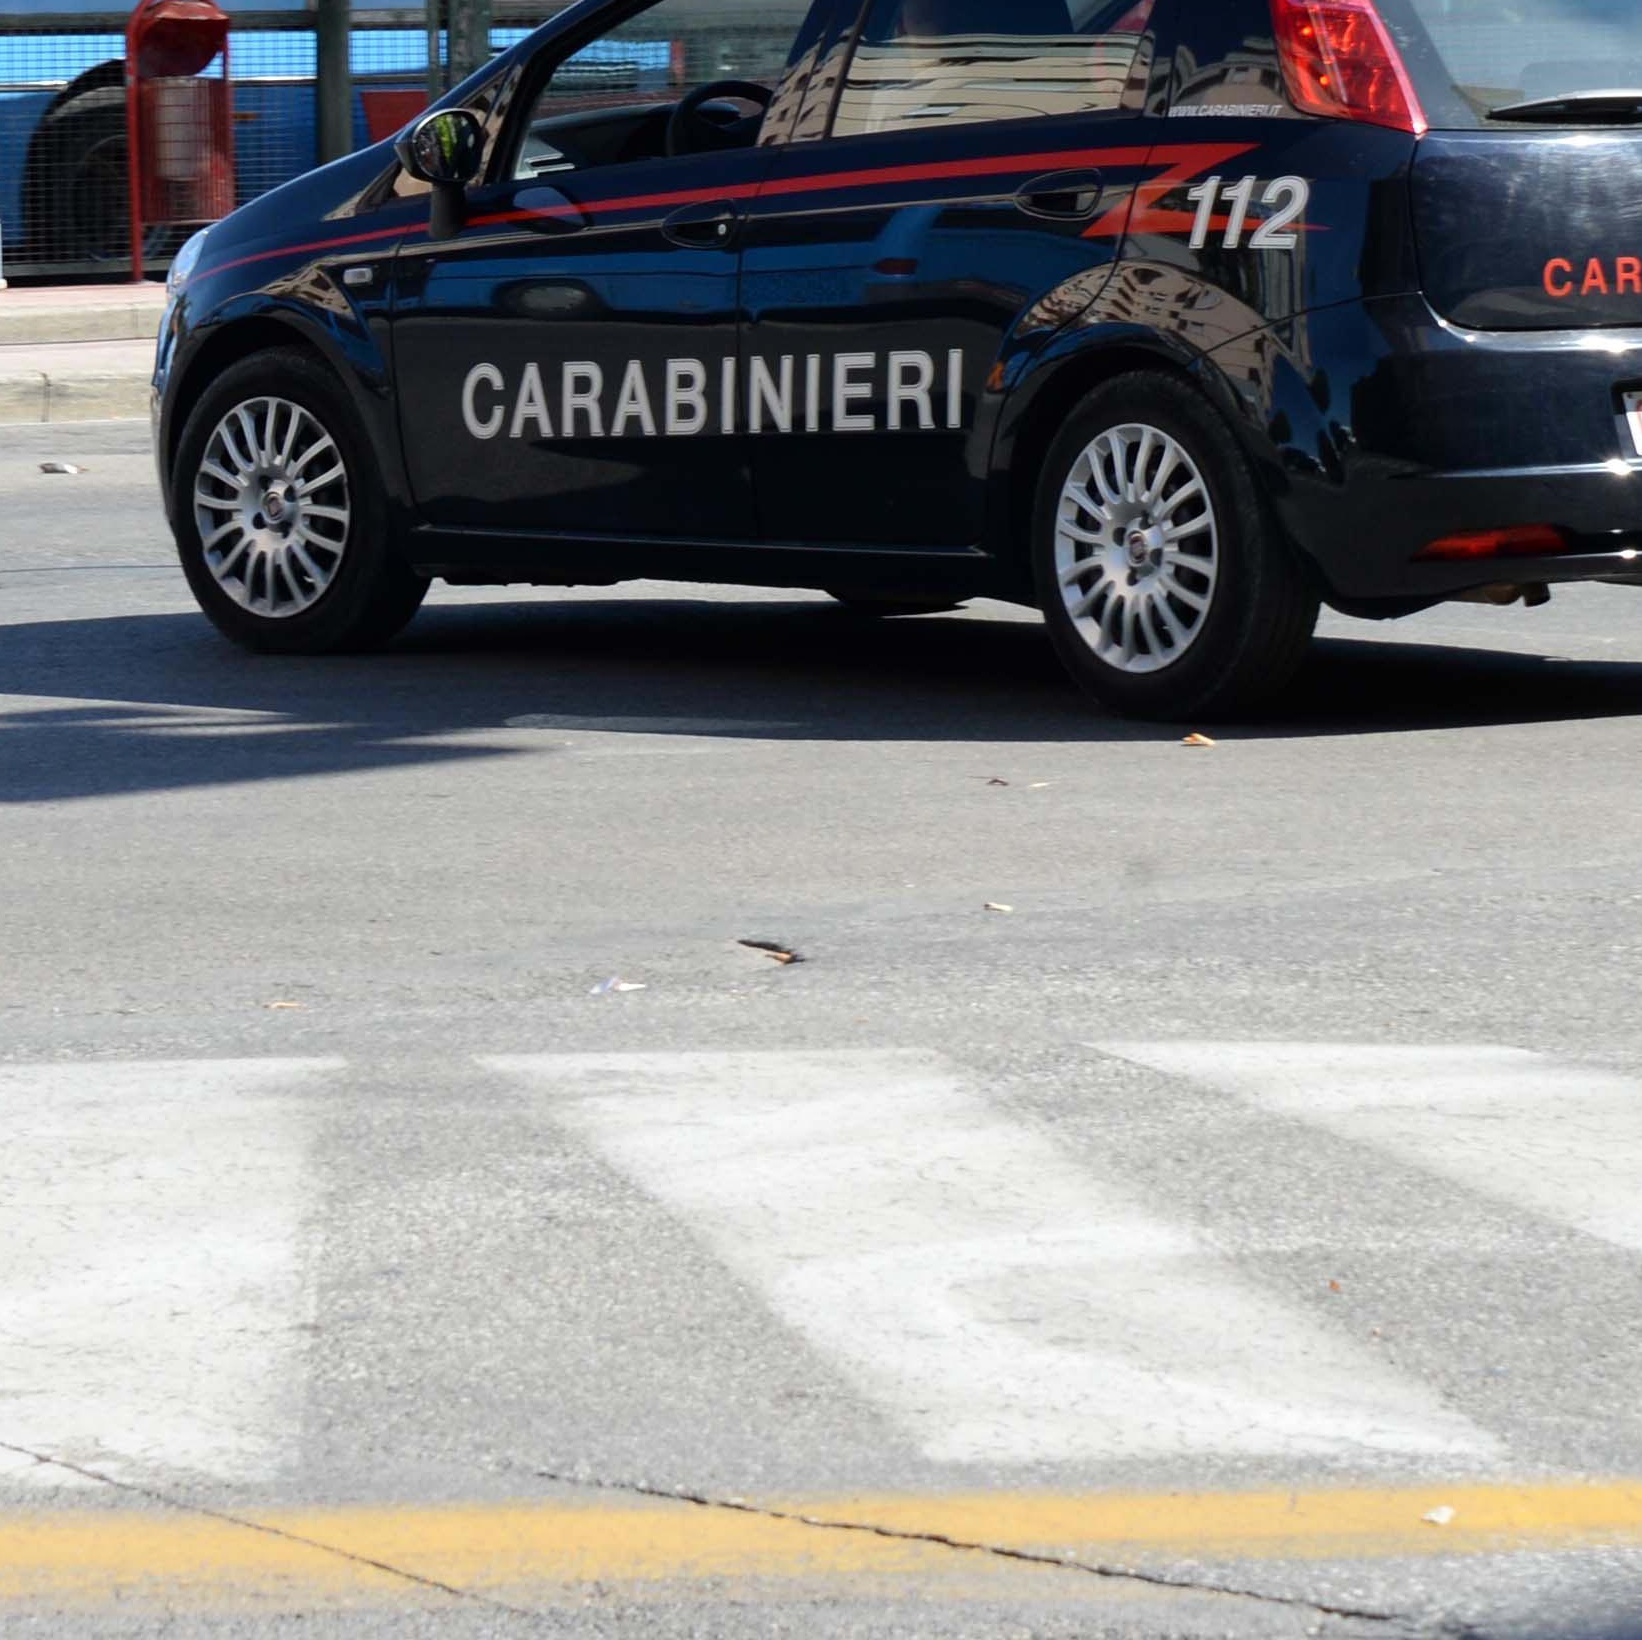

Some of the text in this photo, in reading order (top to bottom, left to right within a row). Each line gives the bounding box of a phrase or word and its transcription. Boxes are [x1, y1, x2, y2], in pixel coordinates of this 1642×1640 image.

[1168, 103, 1284, 118] WWW.CARABINIERI.IT
[1187, 175, 1310, 249] 112
[460, 348, 963, 440] CARABINIERI
